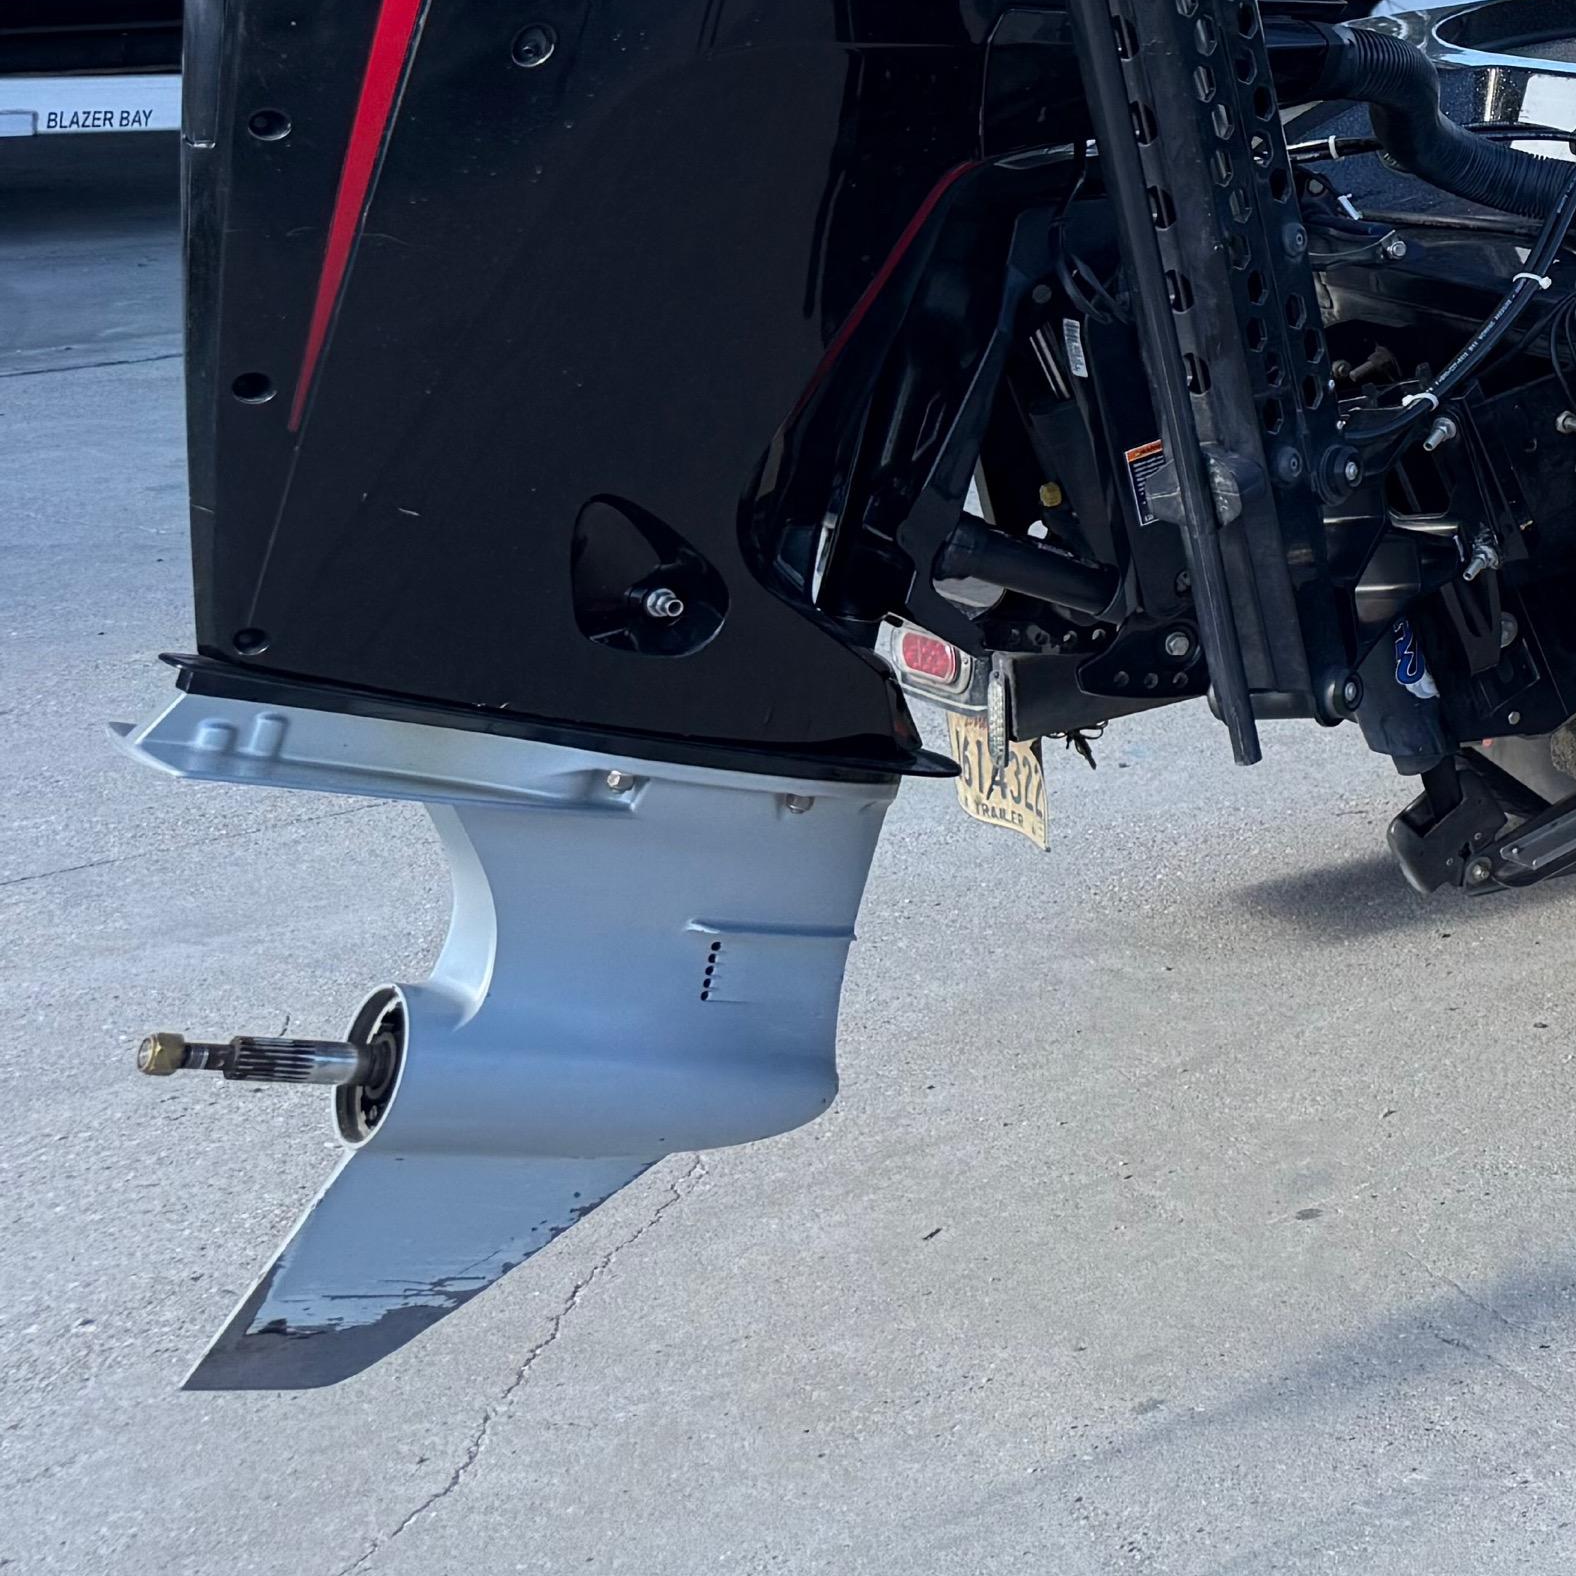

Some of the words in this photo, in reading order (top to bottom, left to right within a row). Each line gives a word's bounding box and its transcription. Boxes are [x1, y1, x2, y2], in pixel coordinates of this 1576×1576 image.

[46, 110, 114, 129] BLAZER
[119, 109, 153, 127] BAY
[974, 801, 1024, 827] TRAILER
